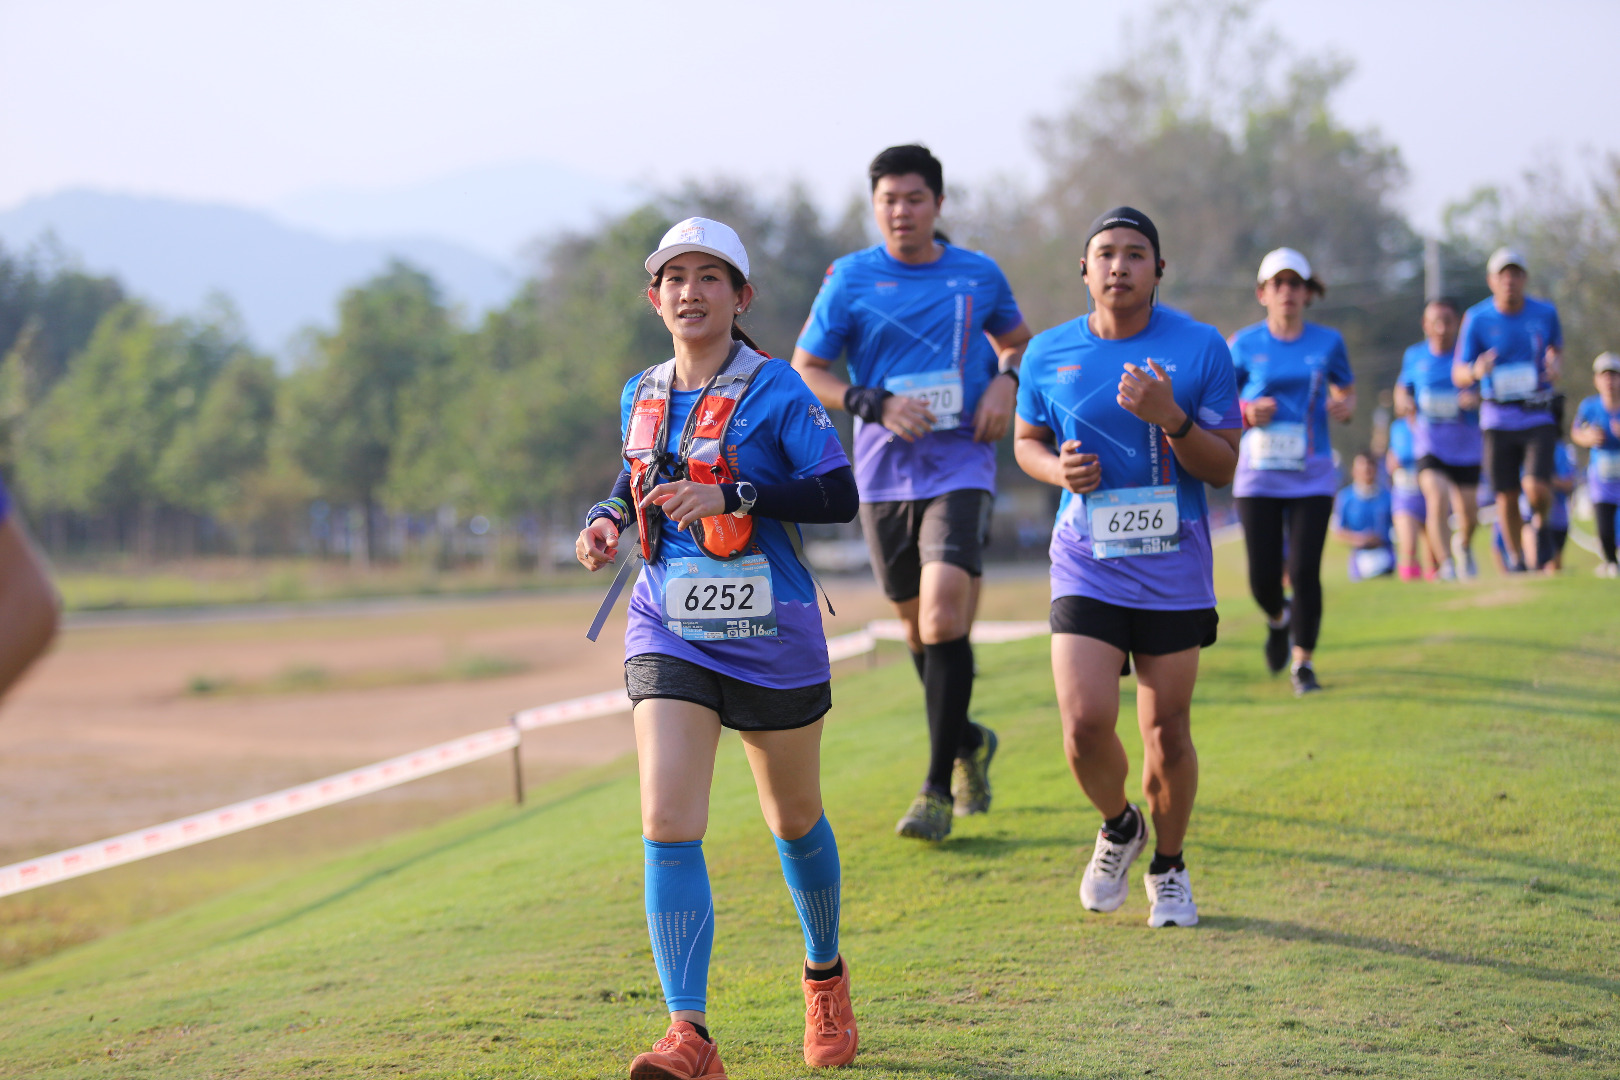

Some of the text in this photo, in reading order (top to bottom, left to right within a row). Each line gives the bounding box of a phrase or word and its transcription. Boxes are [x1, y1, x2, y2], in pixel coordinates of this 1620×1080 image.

[734, 418, 748, 427] XC
[1108, 509, 1163, 532] 6256
[684, 583, 755, 611] 6252
[751, 623, 765, 637] 16
